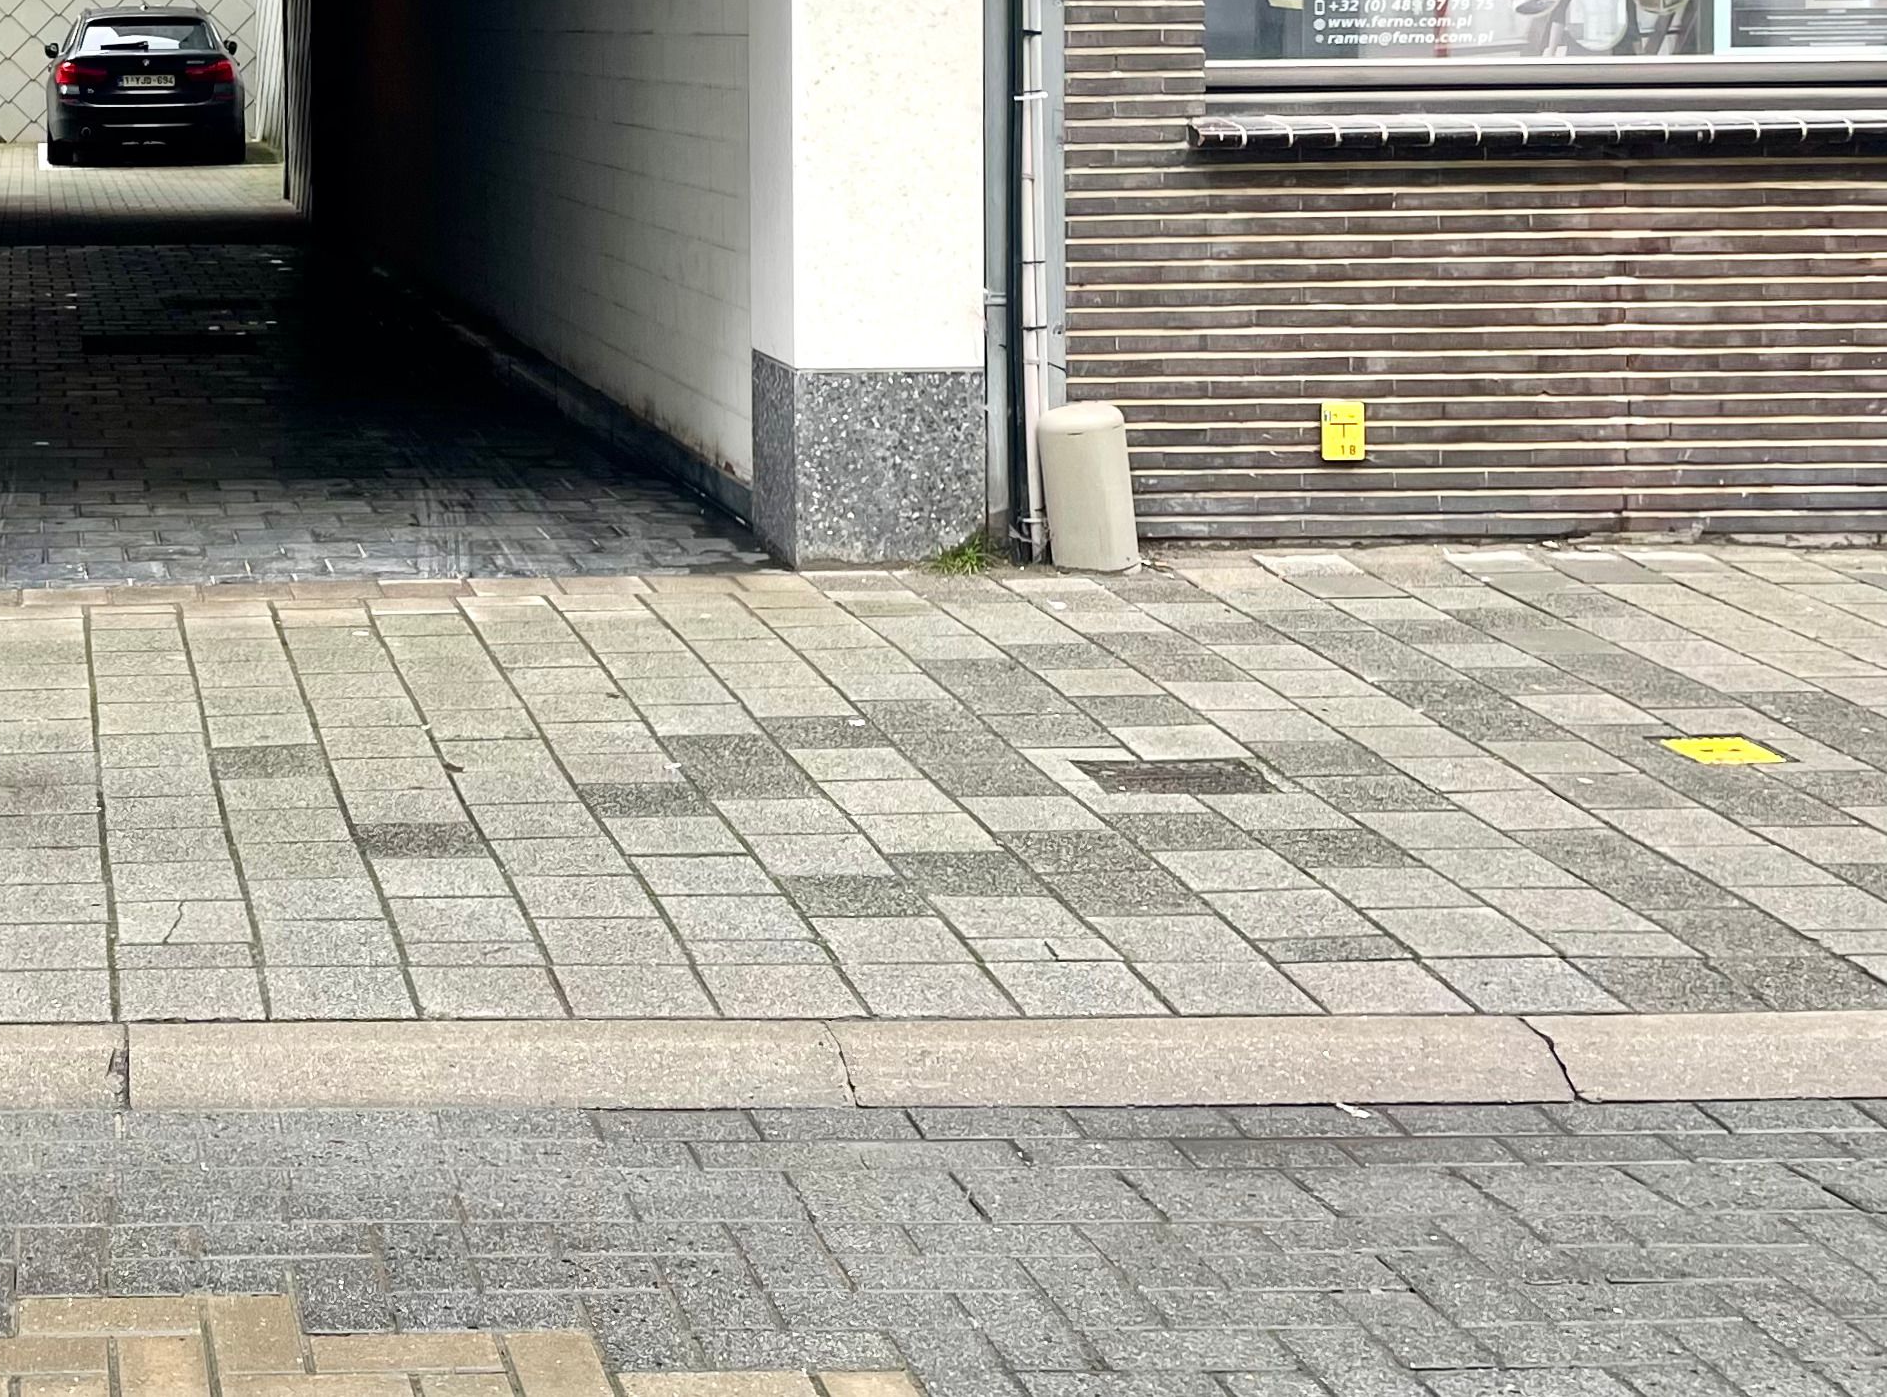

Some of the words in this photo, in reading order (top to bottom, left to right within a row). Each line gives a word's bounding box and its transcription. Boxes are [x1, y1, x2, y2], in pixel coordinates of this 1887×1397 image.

[1328, 0, 1359, 12] +32
[1364, 0, 1386, 13] (0)
[1327, 15, 1472, 29] www.ferno.com.pl
[1327, 31, 1494, 46] ramen@ferno.com.pl
